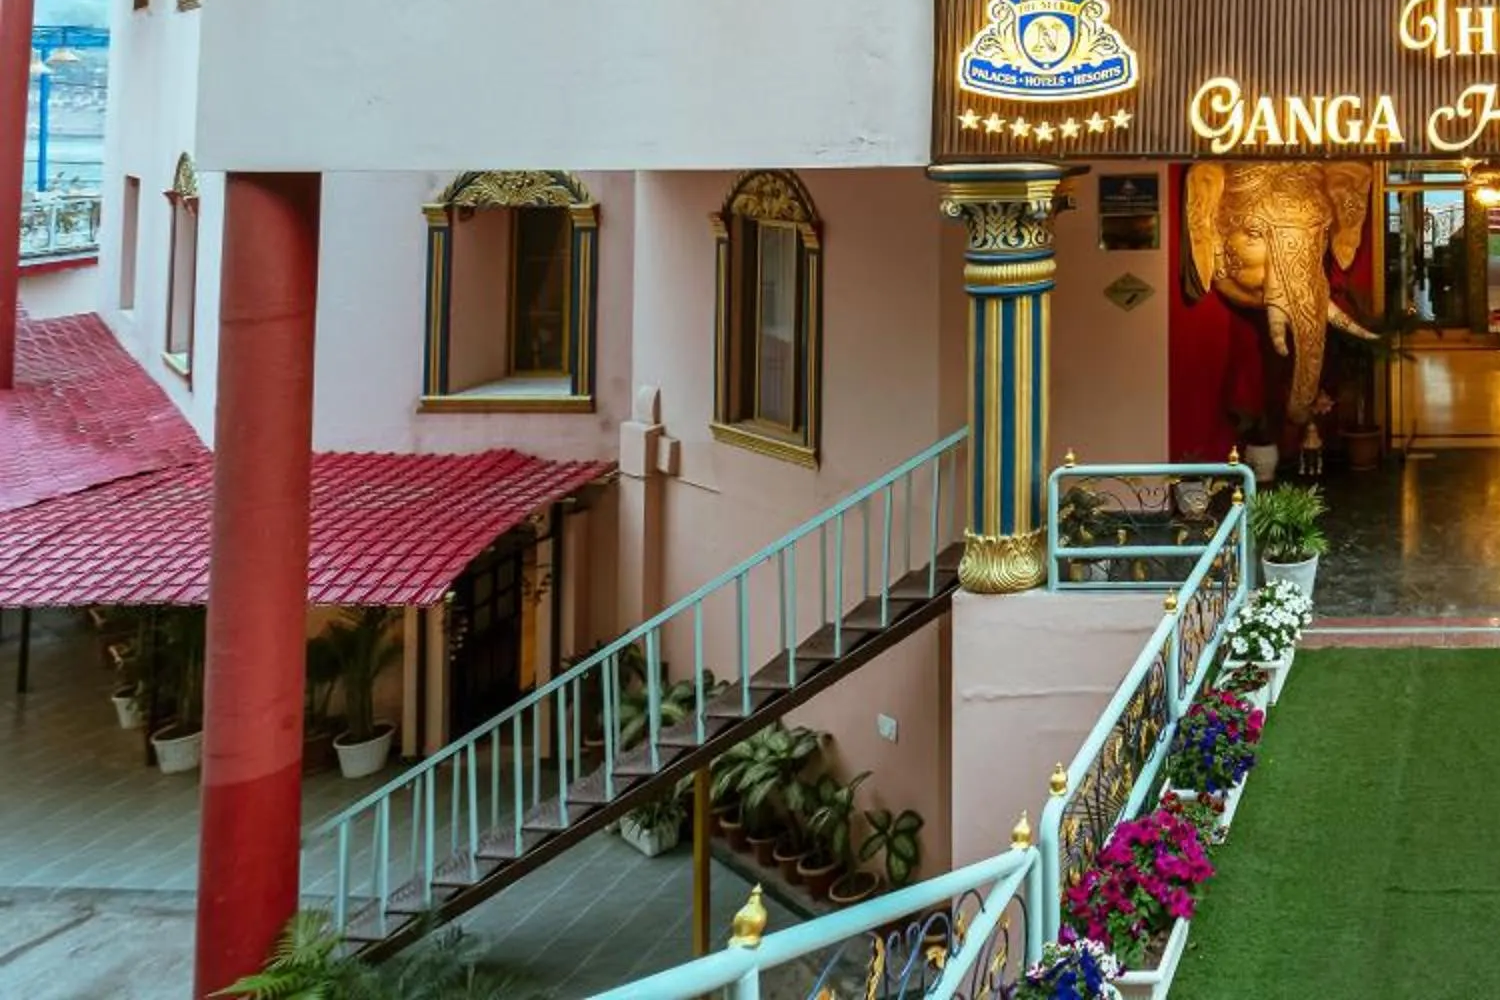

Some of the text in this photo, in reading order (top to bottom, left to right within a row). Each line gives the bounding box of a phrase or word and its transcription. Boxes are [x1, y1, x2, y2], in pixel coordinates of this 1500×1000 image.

[1025, 75, 1065, 87] HOTELS
[1073, 66, 1122, 85] RESORTS
[1188, 75, 1406, 155] GANGA
